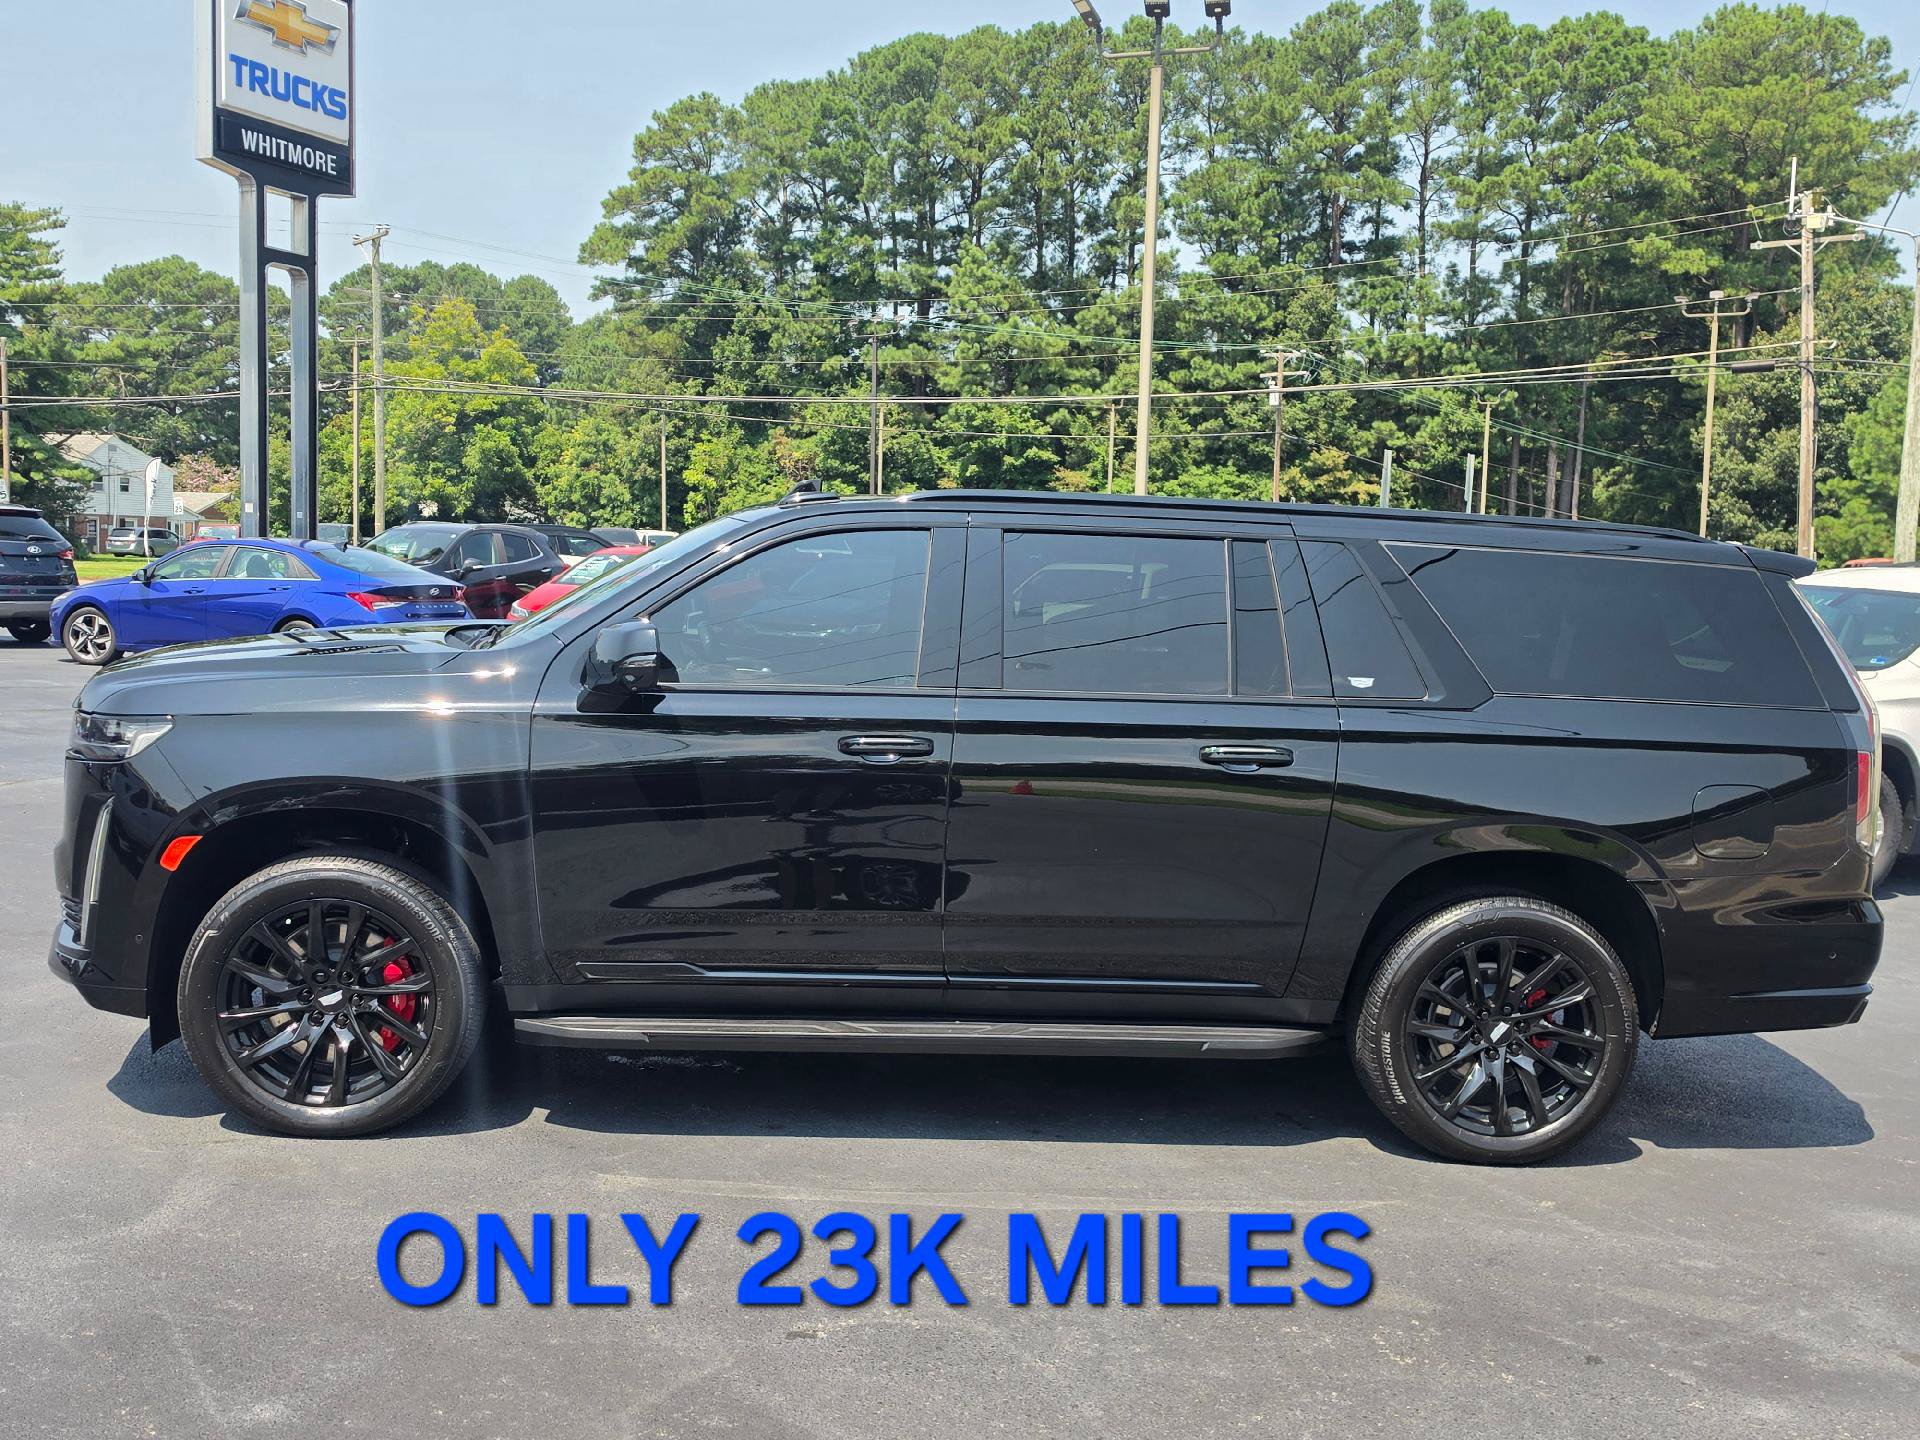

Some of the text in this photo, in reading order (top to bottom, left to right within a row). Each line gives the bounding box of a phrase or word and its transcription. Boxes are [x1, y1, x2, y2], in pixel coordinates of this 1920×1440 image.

[229, 53, 347, 121] TRUCKS
[241, 128, 337, 175] WHITMORE
[380, 884, 444, 943] BRIDGESTONE
[1381, 1030, 1407, 1104] BRIDGESTONE
